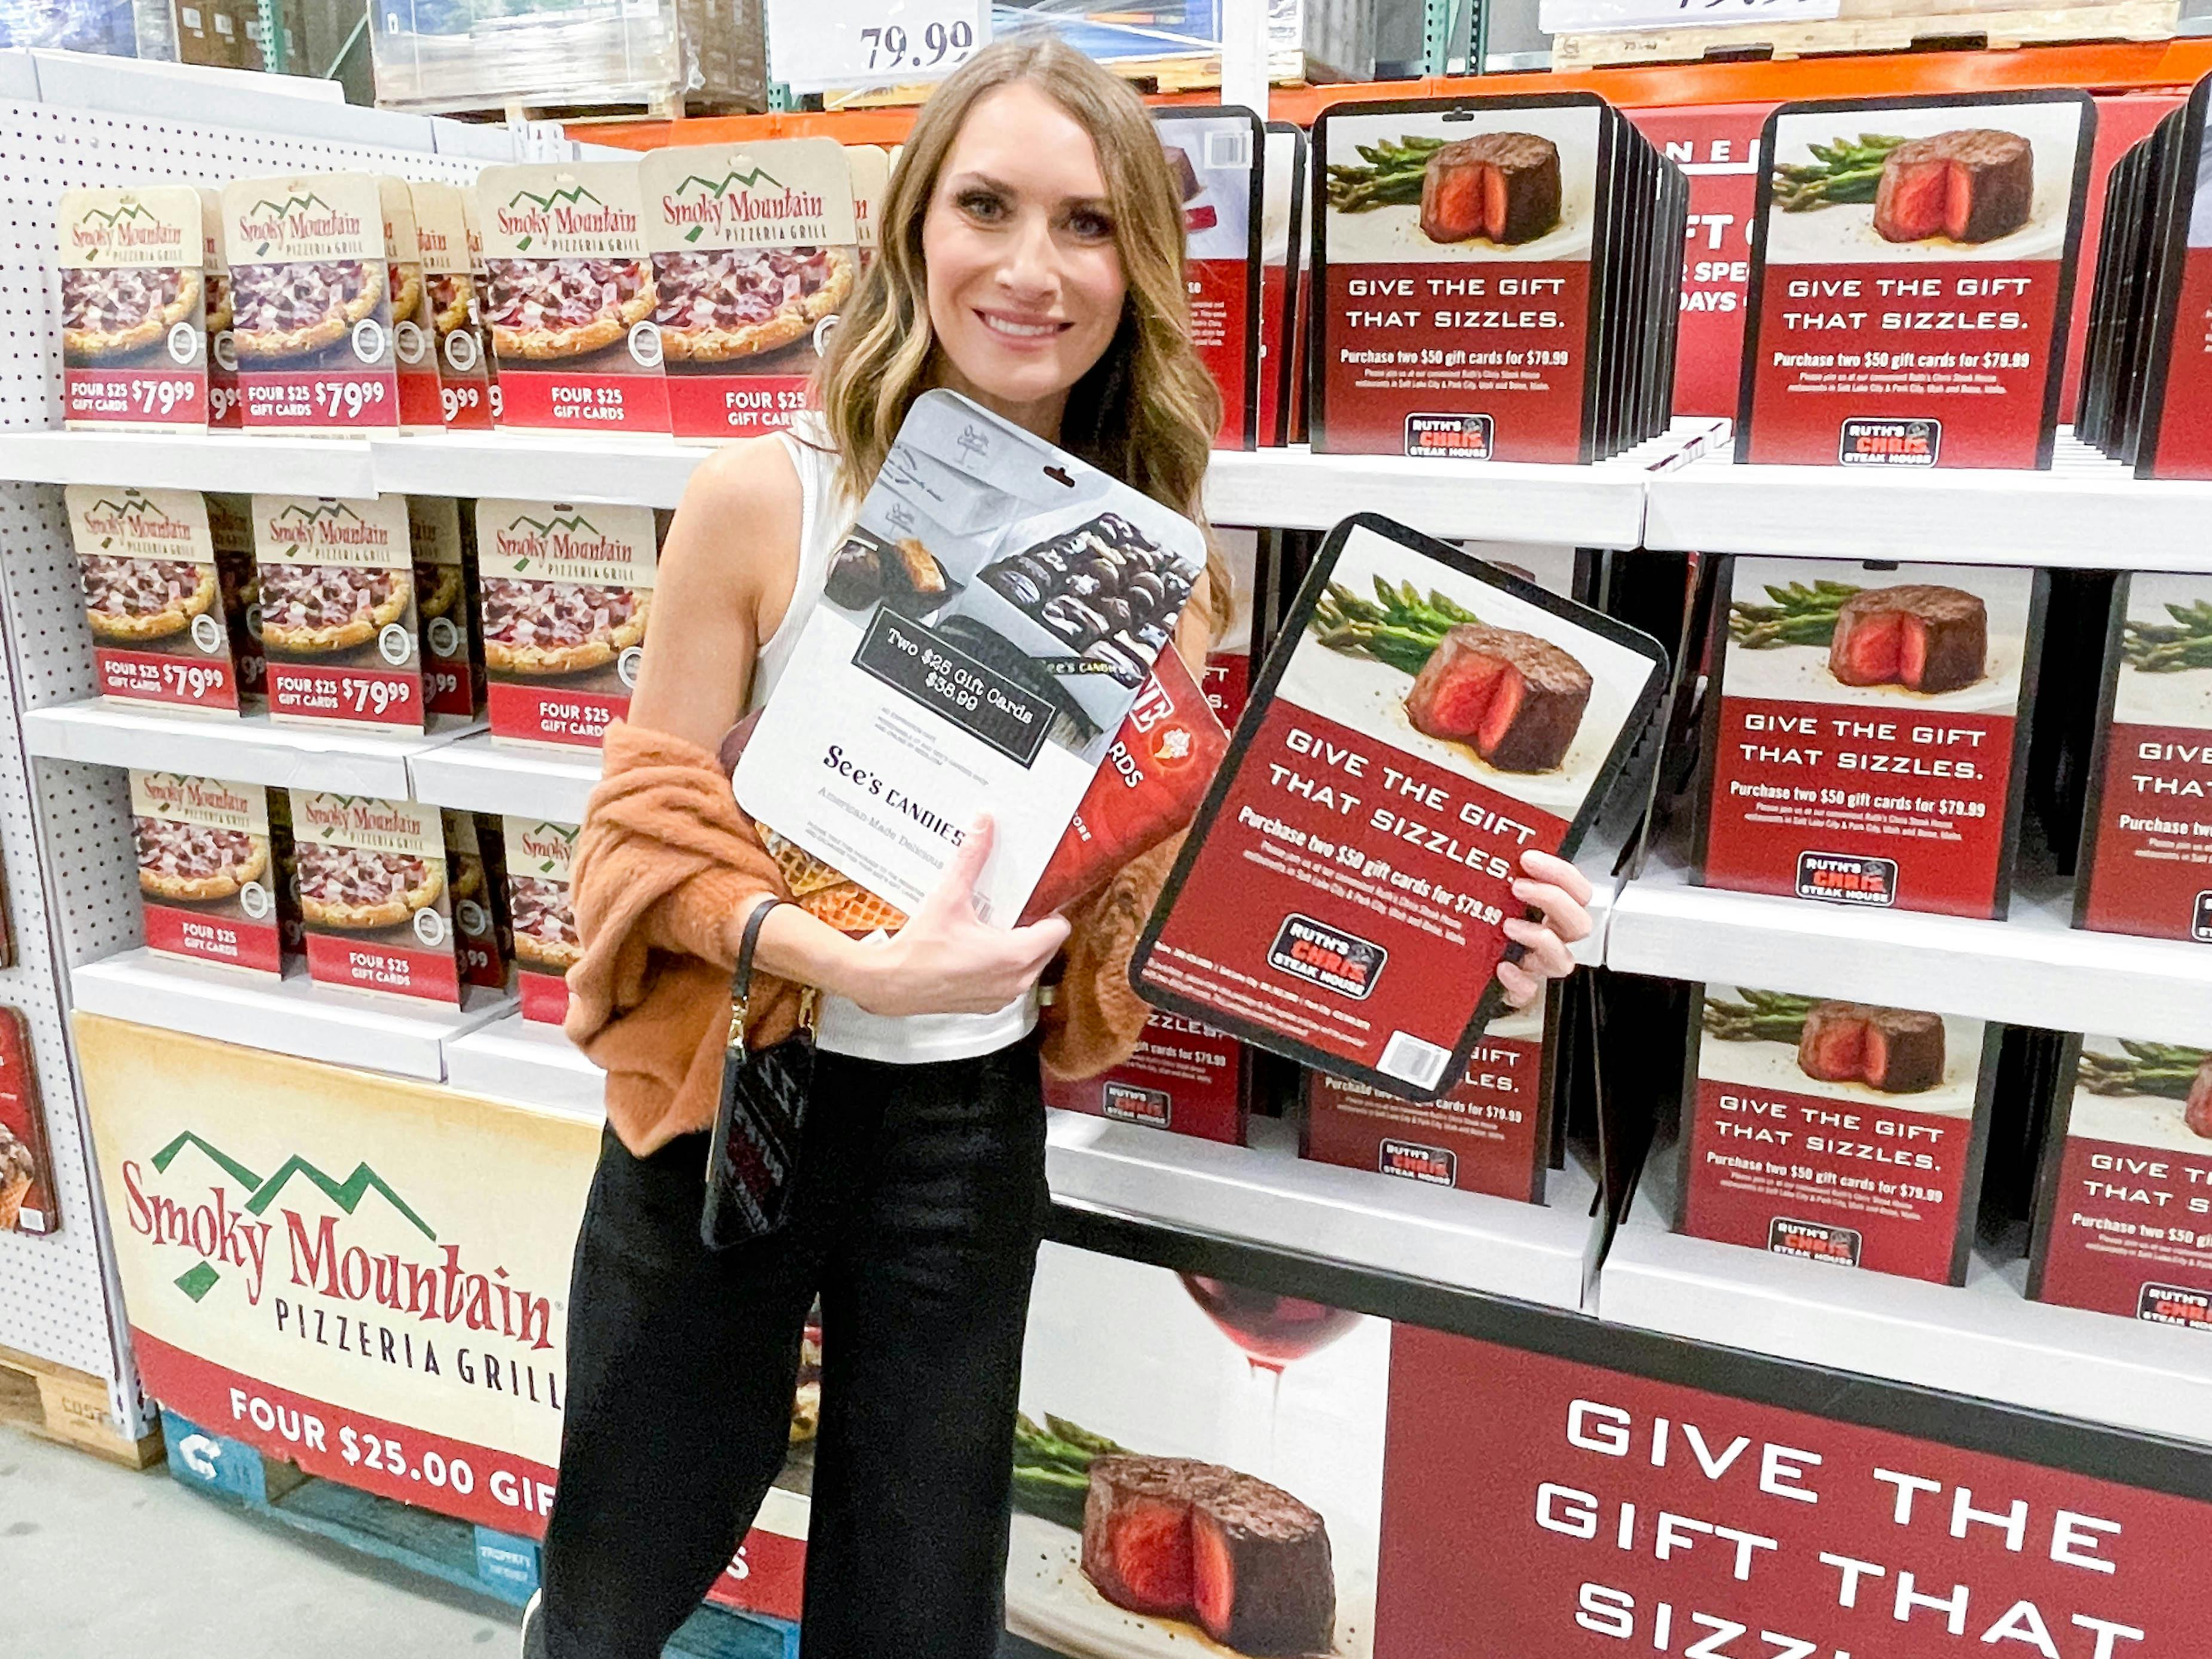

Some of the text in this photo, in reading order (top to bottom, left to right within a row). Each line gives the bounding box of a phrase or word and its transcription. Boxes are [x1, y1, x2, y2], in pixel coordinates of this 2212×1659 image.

[860, 20, 972, 69] 79.99
[498, 204, 637, 245] Smoky Mountain
[663, 188, 824, 240] Smoky Mountain
[726, 224, 827, 241] PIZZERIA GRILL
[552, 238, 640, 252] PIZZERIA GRILL
[1349, 278, 1565, 296] GIVE THE GIFT
[1788, 278, 2032, 298] GIVE THE GIFT
[1346, 311, 1565, 328] THAT SIZZLES.
[1783, 312, 2028, 330] THAT SIZZLES.
[1341, 349, 1522, 366] Purchase two $50 gift cards for
[1773, 351, 1834, 368] Purchase
[1837, 353, 1861, 367] two
[1865, 351, 1888, 368] $50
[1891, 352, 1914, 370] gift
[1917, 352, 1956, 368] cards
[1960, 353, 1979, 368] for
[72, 382, 128, 397] FOUR $25
[248, 385, 309, 400] FOUR $25
[552, 387, 623, 405] FOUR $25
[726, 391, 805, 410] FOUR $25
[250, 403, 311, 416] GIFT CARDS
[554, 405, 624, 420] GIFT CARDS
[728, 411, 758, 426] GIFT
[1849, 425, 1905, 437] RUTH'S
[270, 519, 316, 549] Smoky
[497, 529, 632, 569] Smoky Mountain
[604, 565, 634, 581] GRILL
[105, 660, 160, 678] FOUR $25
[887, 627, 1033, 724] Two $25 Gift Cards
[277, 677, 337, 695] FOUR $25
[925, 671, 978, 712] $38.99
[279, 694, 338, 709] GIFT CARDS
[540, 702, 609, 722] FOUR $25
[541, 720, 566, 733] GIFT
[1745, 714, 1986, 747] GIVE THE GIFT
[1108, 740, 1145, 788] RDS
[1740, 744, 1984, 780] THAT SIZZLES.
[823, 745, 883, 795] See's
[885, 789, 966, 847] CANDIES
[1286, 727, 1536, 846] GIVE THE GIFT
[1730, 780, 1790, 800] Purchase
[1794, 787, 1817, 802] two
[1821, 788, 1844, 805] $50
[1847, 791, 1871, 808] gift
[1874, 795, 1911, 812] cards
[1915, 798, 1935, 813] for
[1269, 763, 1513, 883] THAT SIZZLES.
[2119, 815, 2188, 835] Purchase
[1238, 805, 1503, 926] Purchase two $50 gift cards for $79.99
[1806, 858, 1861, 874] RUTH'S
[182, 923, 237, 944] FOUR $25
[1289, 922, 1350, 956] RUTH'S
[349, 951, 410, 974] FOUR $25
[1274, 953, 1365, 996] STEAK HOUSE
[351, 966, 411, 987] GIFT CARDS
[1720, 1095, 1944, 1143] GIVE THE GIFT
[1715, 1121, 1941, 1171] THAT SIZZLES.
[1706, 1151, 1897, 1195] Purchase two $50 gift cards for
[2091, 1153, 2169, 1179] GIVE
[2083, 1180, 2174, 1207] THAT
[122, 1160, 554, 1351] Smoky Mountain
[276, 1297, 562, 1411] PIZZERIA GRILL
[230, 1388, 556, 1517] FOUR $25.00 GIF
[1566, 1397, 2122, 1574] GIVE THE
[1535, 1482, 2144, 1659] GIFT THAT
